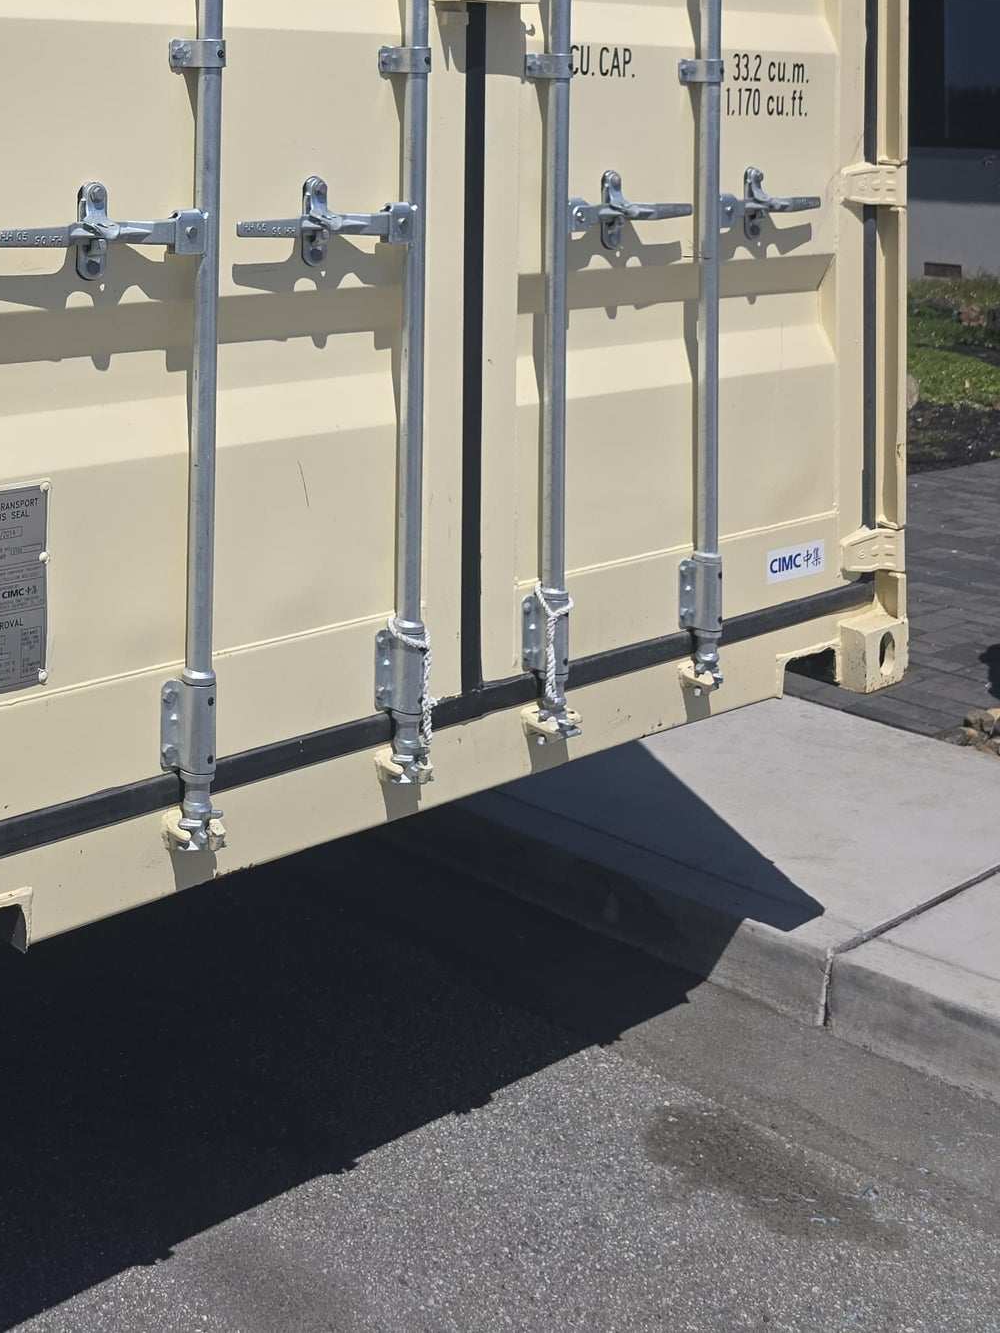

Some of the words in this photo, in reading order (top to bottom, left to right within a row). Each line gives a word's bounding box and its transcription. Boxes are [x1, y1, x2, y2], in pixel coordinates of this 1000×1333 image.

[733, 52, 762, 82] 33.2
[11, 509, 30, 520] SEAL
[769, 553, 802, 574] CIMC
[803, 547, 822, 568] 中集
[1, 587, 25, 600] CIMC
